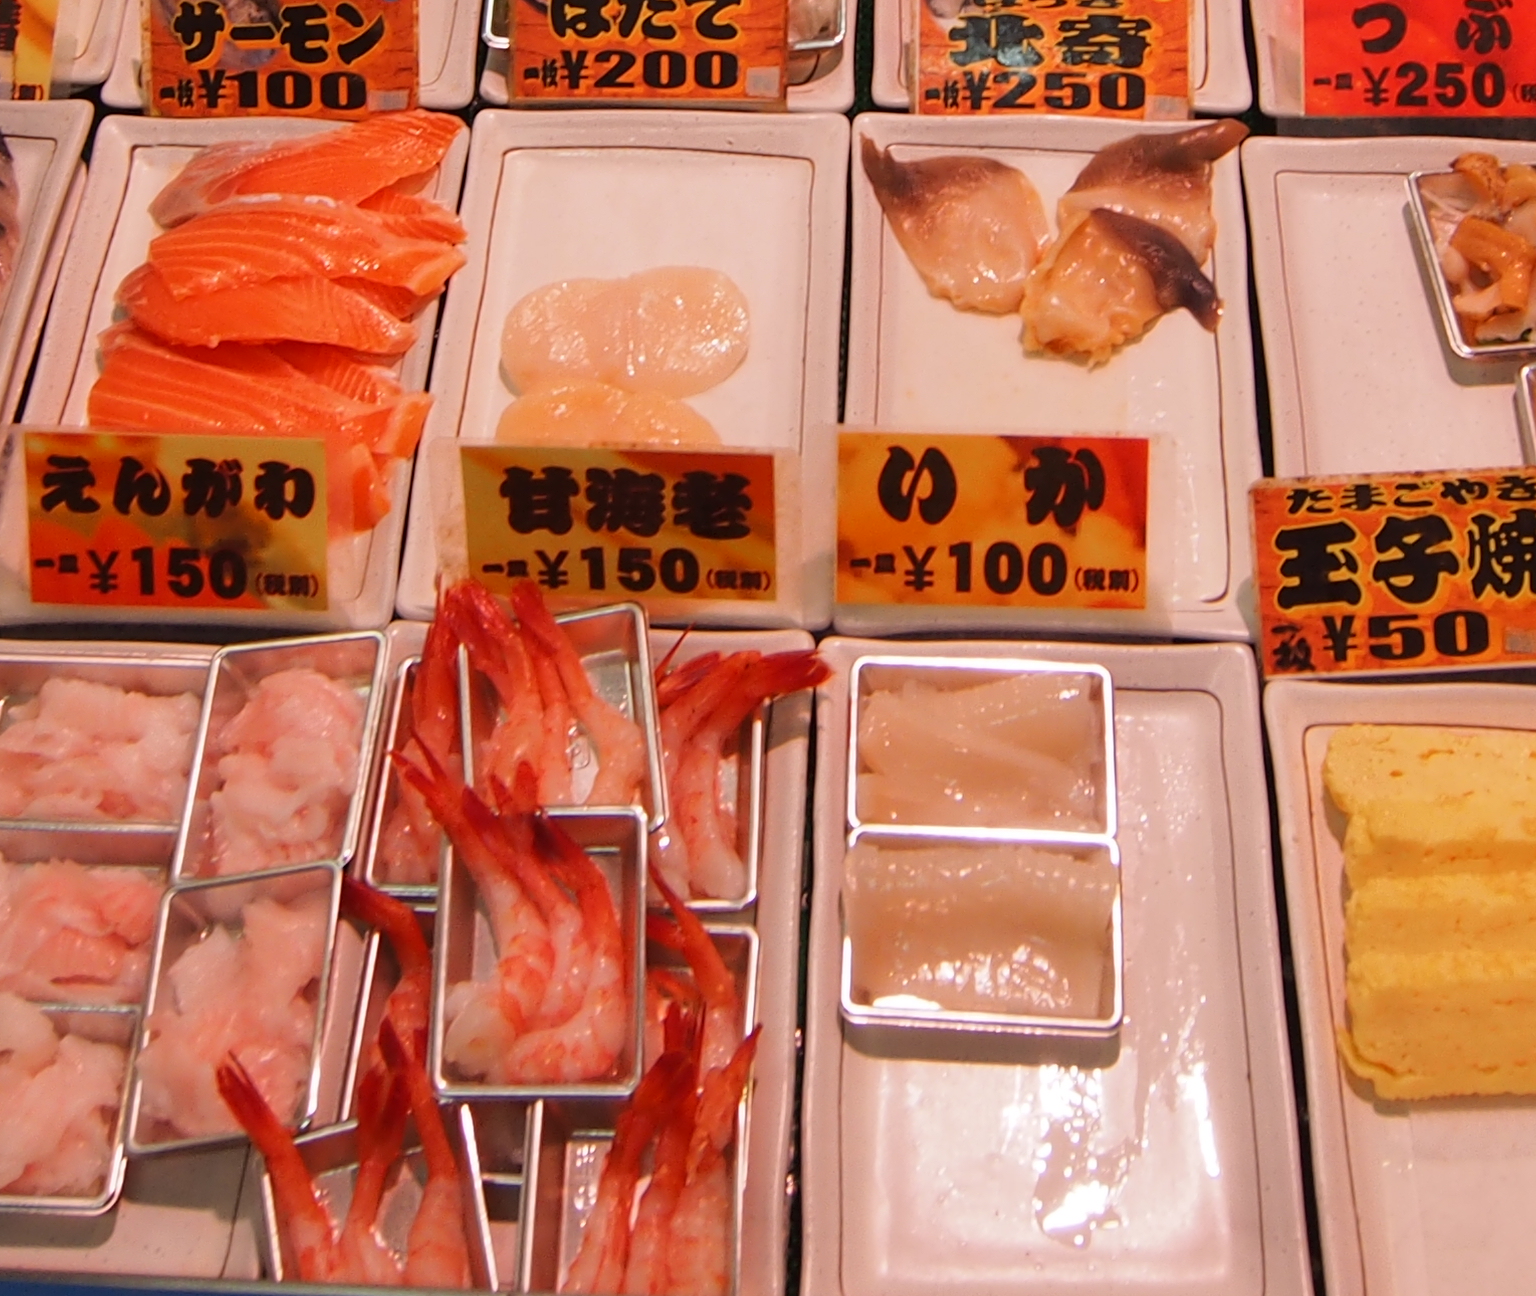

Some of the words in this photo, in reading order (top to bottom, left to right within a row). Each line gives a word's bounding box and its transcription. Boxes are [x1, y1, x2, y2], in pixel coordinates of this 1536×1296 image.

[173, 1, 385, 65] サーモン
[949, 14, 1152, 68] 北寄
[40, 455, 315, 521] えんがわ
[499, 466, 753, 540] 甘海老
[878, 446, 1106, 528] いか
